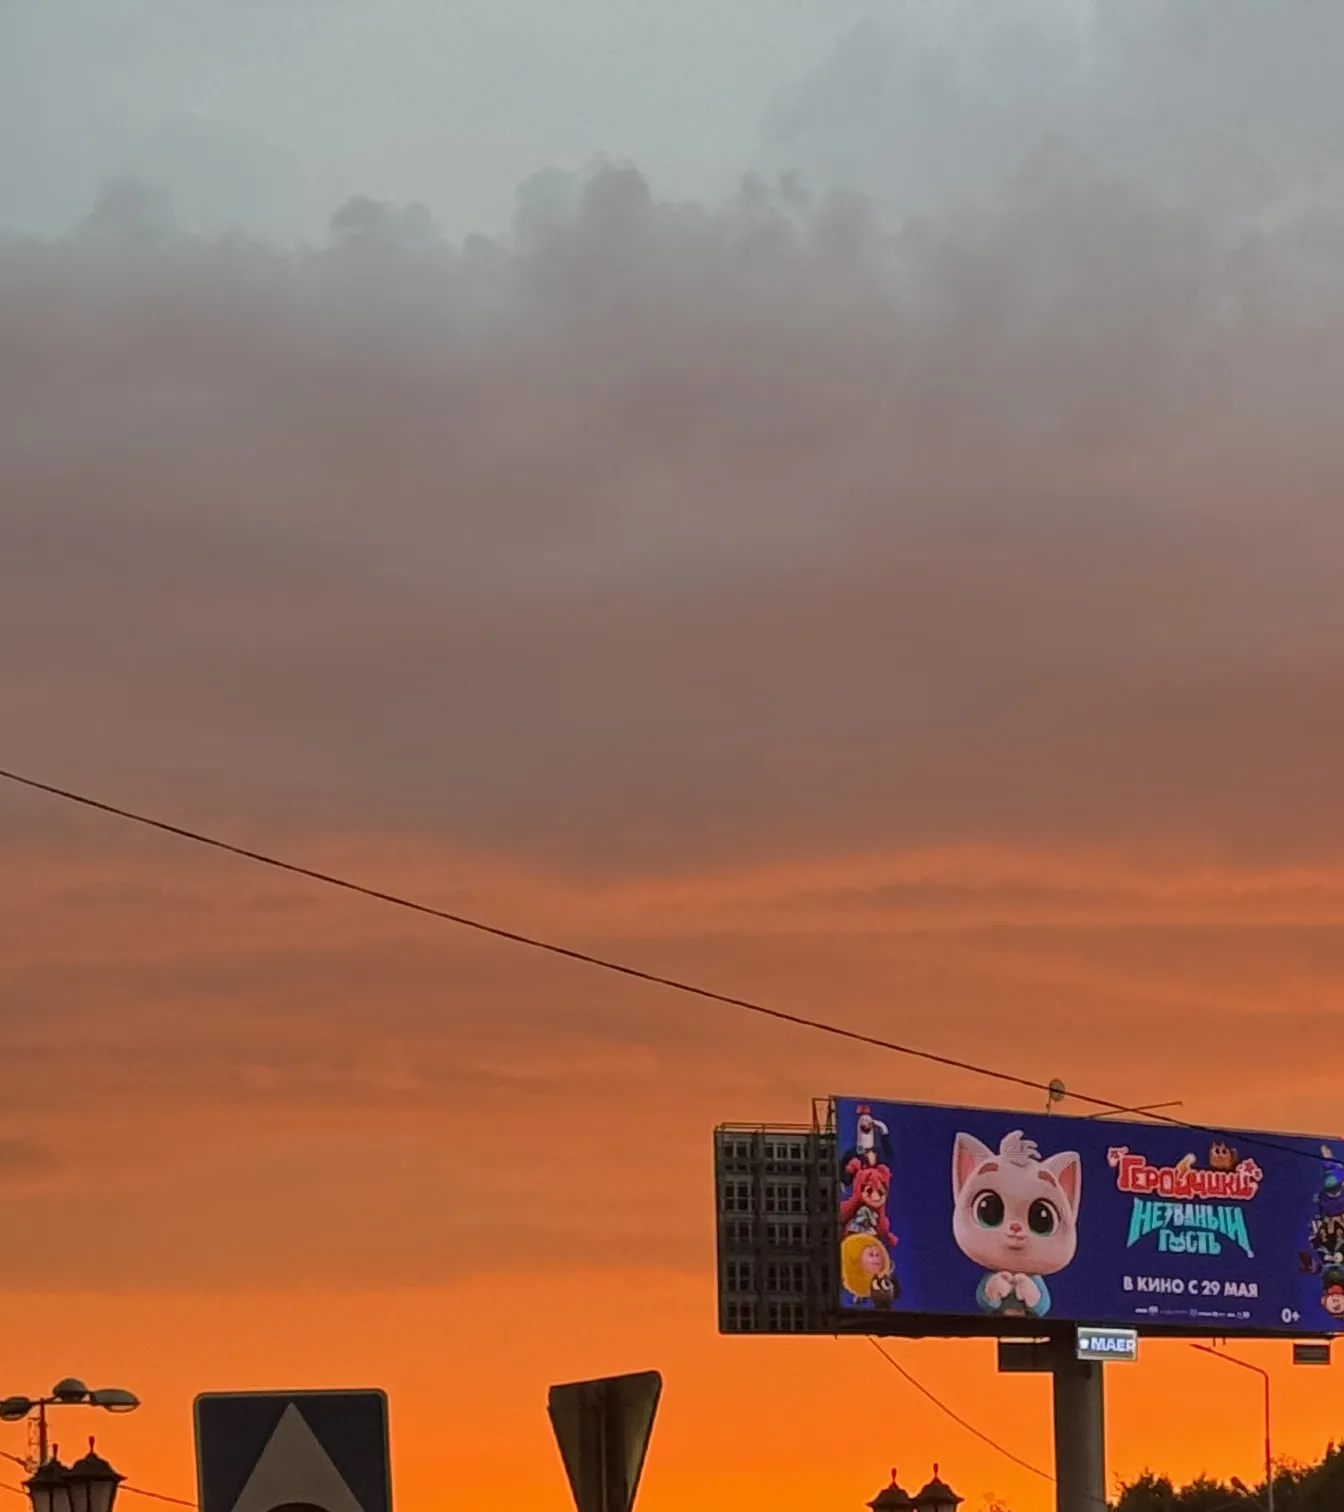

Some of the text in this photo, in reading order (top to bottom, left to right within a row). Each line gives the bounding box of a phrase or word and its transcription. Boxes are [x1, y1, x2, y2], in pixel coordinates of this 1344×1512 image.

[1123, 1275, 1259, 1298] В КИНО С 29 МАЯ
[1281, 1308, 1300, 1323] 0+
